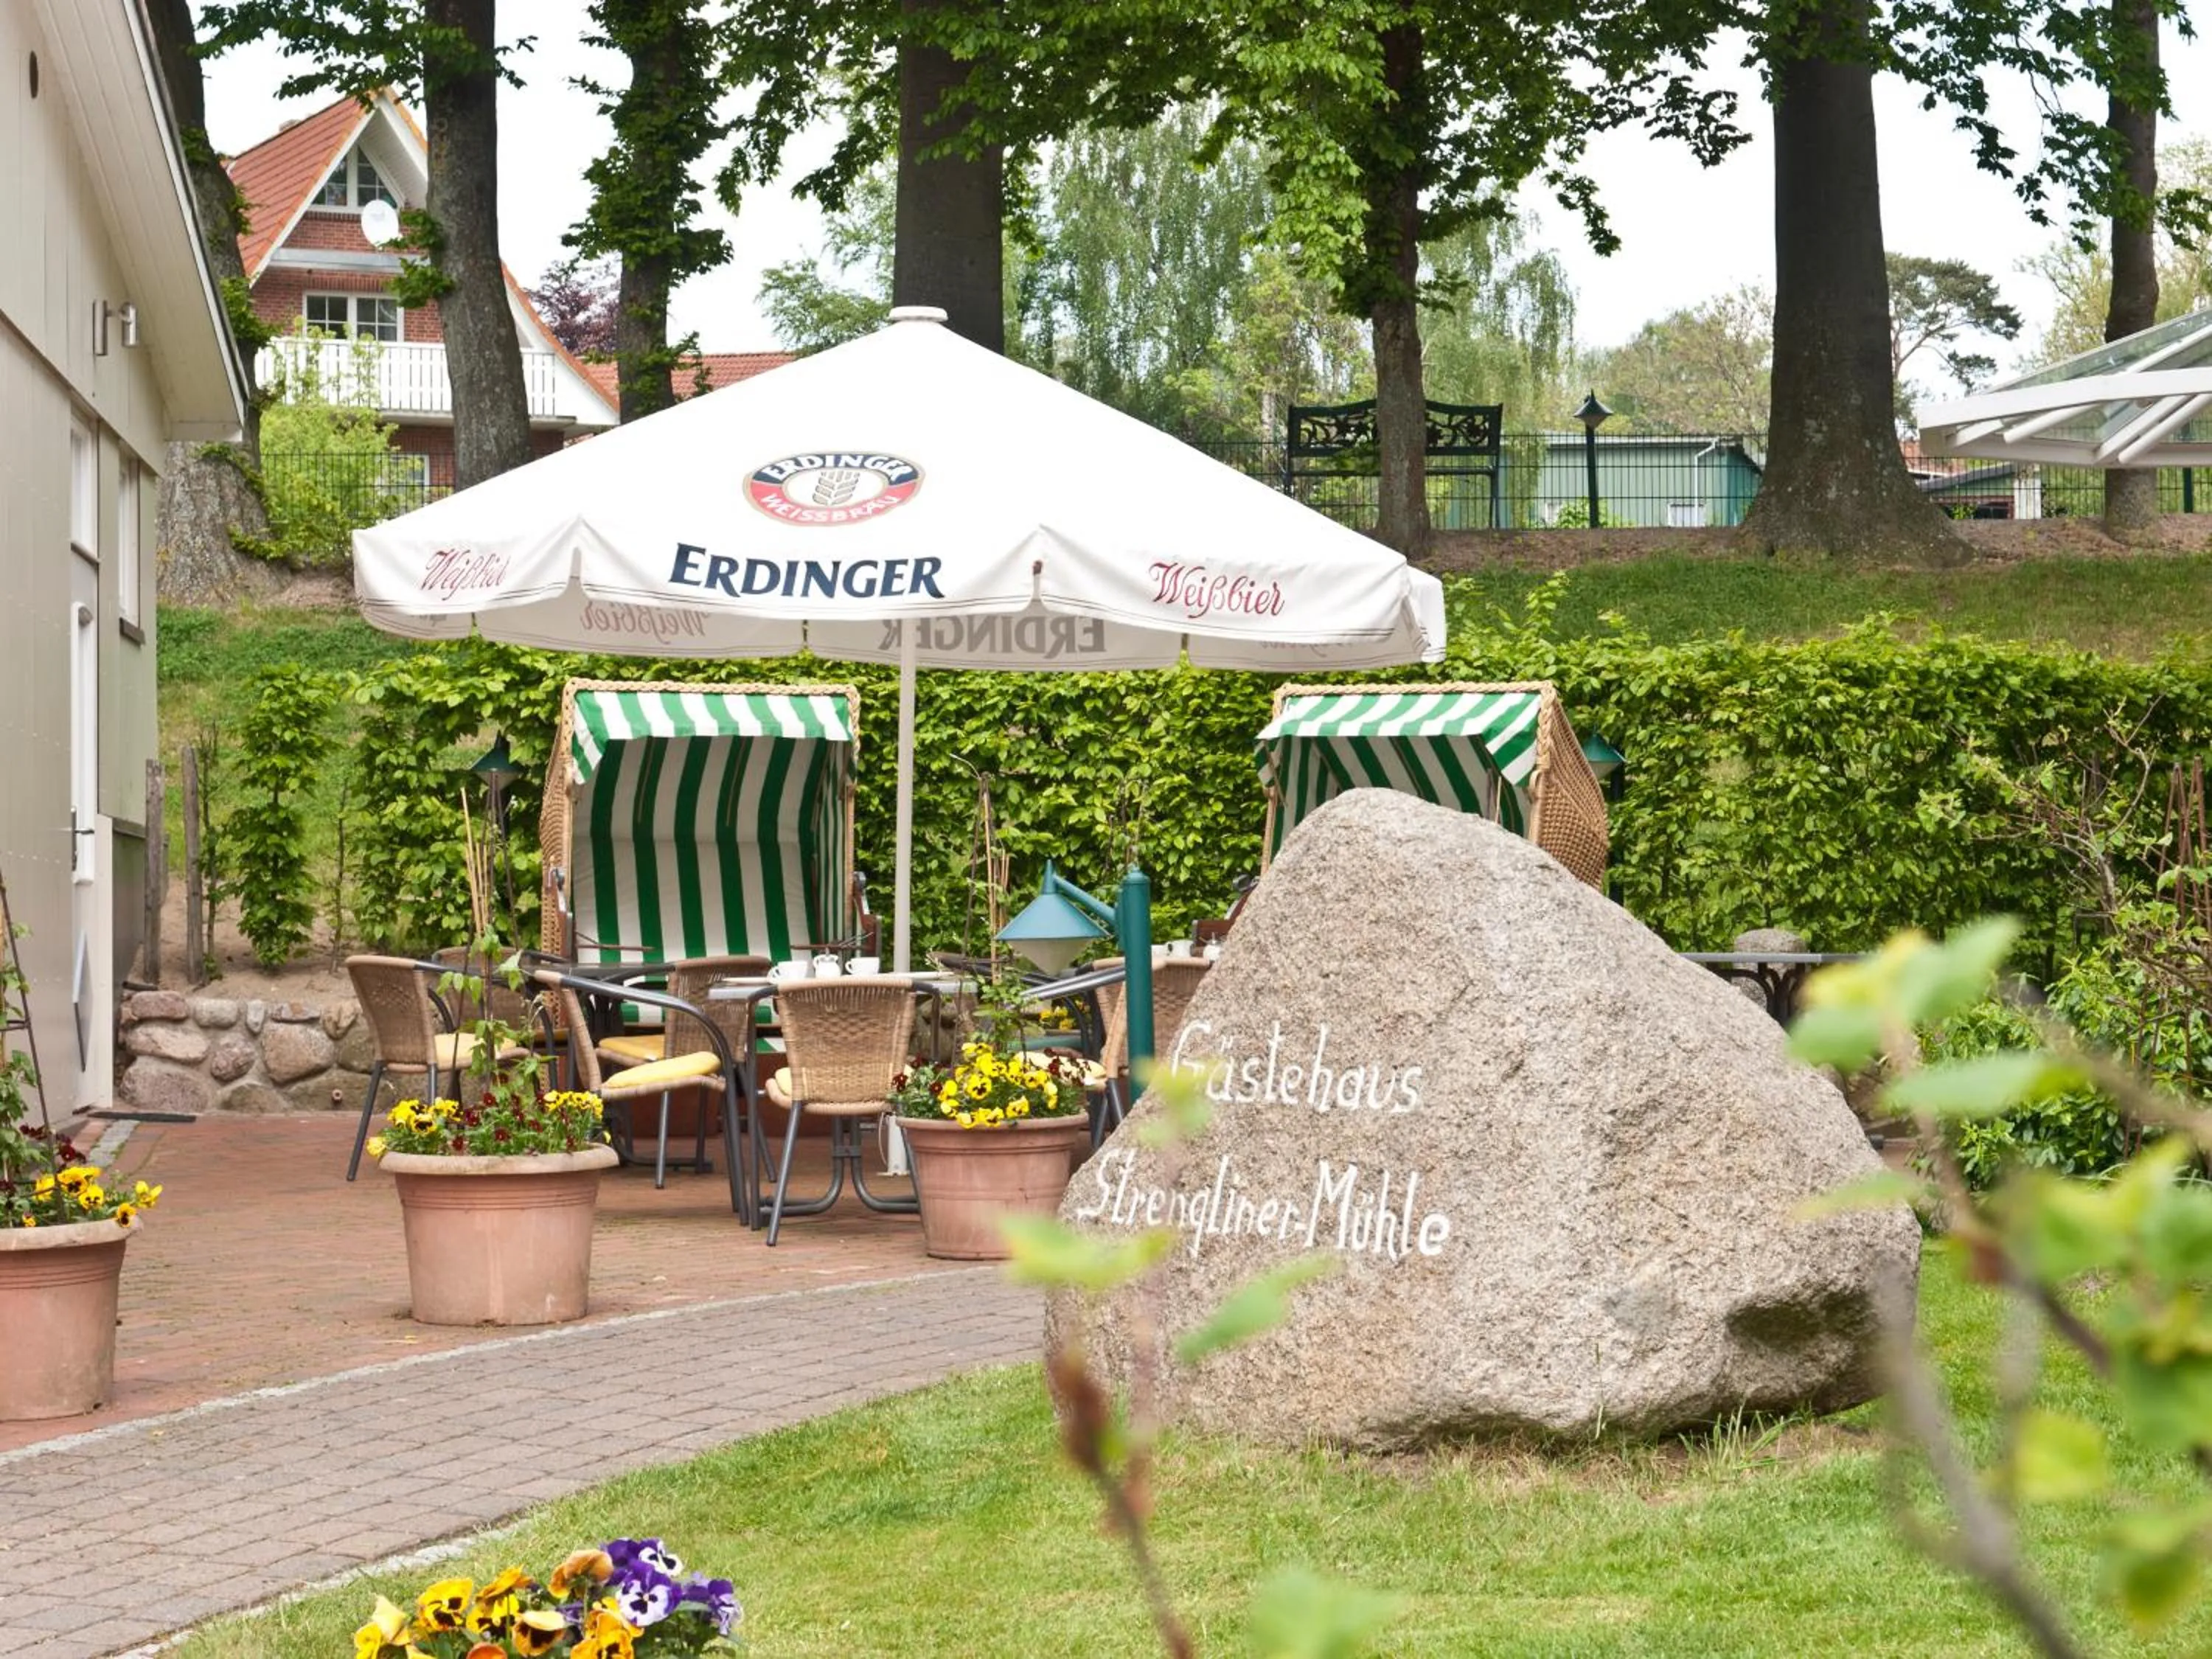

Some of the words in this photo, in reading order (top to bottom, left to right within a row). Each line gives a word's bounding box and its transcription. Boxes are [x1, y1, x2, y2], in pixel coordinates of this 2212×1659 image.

[760, 453, 913, 481] ERDINGER
[669, 543, 945, 599] ERDINGER
[1150, 563, 1285, 619] Weißbier
